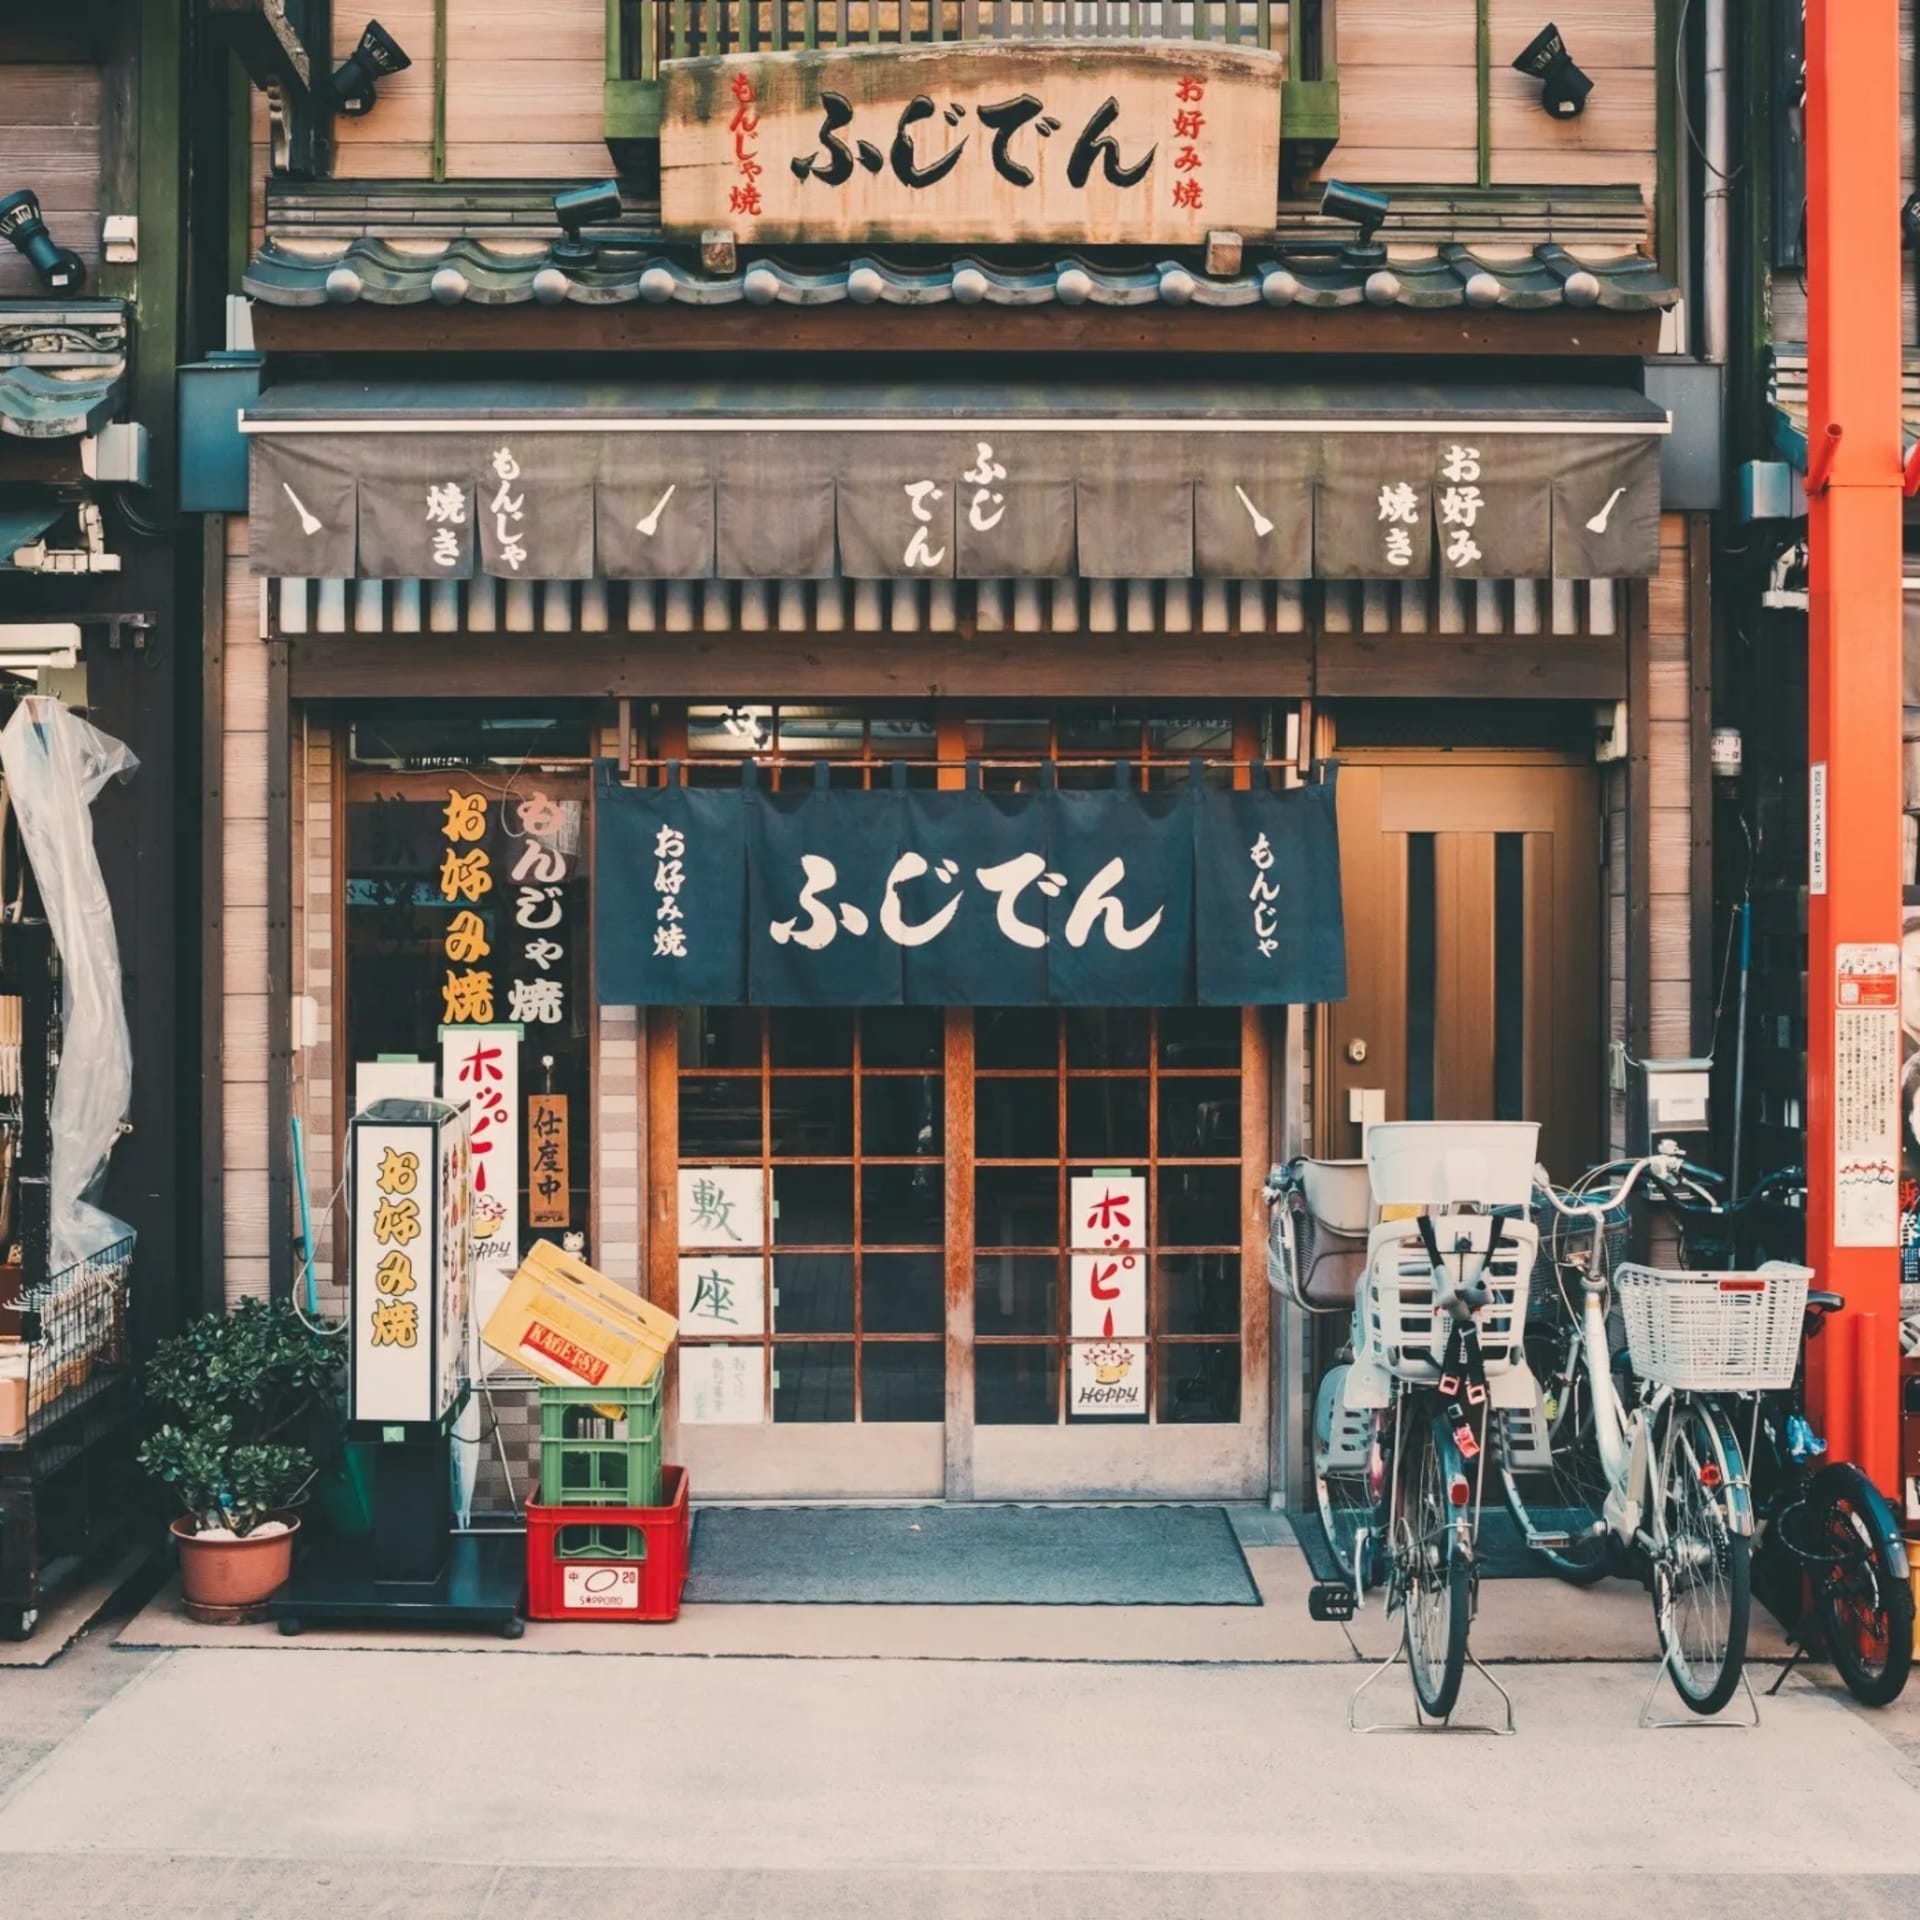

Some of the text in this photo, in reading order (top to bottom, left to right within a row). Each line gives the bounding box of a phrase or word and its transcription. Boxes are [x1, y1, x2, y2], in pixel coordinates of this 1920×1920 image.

[728, 74, 764, 217] もんじゃ焼
[790, 91, 1158, 189] ふじでん
[1172, 75, 1206, 211] お好み焼
[425, 482, 467, 567] 焼き
[488, 446, 529, 571] もんじゃ
[902, 480, 947, 569] でん
[963, 441, 1008, 532] ふじ
[1376, 483, 1419, 567] 焼き
[1441, 444, 1486, 568] お好み
[439, 788, 493, 1025] お好み焼
[507, 790, 567, 1024] もんじゃ焼
[652, 823, 687, 958] お好み焼
[768, 851, 1165, 951] ふじでん
[1247, 832, 1282, 959] もんじゃ
[532, 1106, 564, 1206] 仕度中
[370, 1145, 421, 1350] お好み焼
[1086, 1187, 1136, 1338] ホッピー
[528, 1322, 606, 1377] KAGETSU
[622, 1571, 637, 1584] 20
